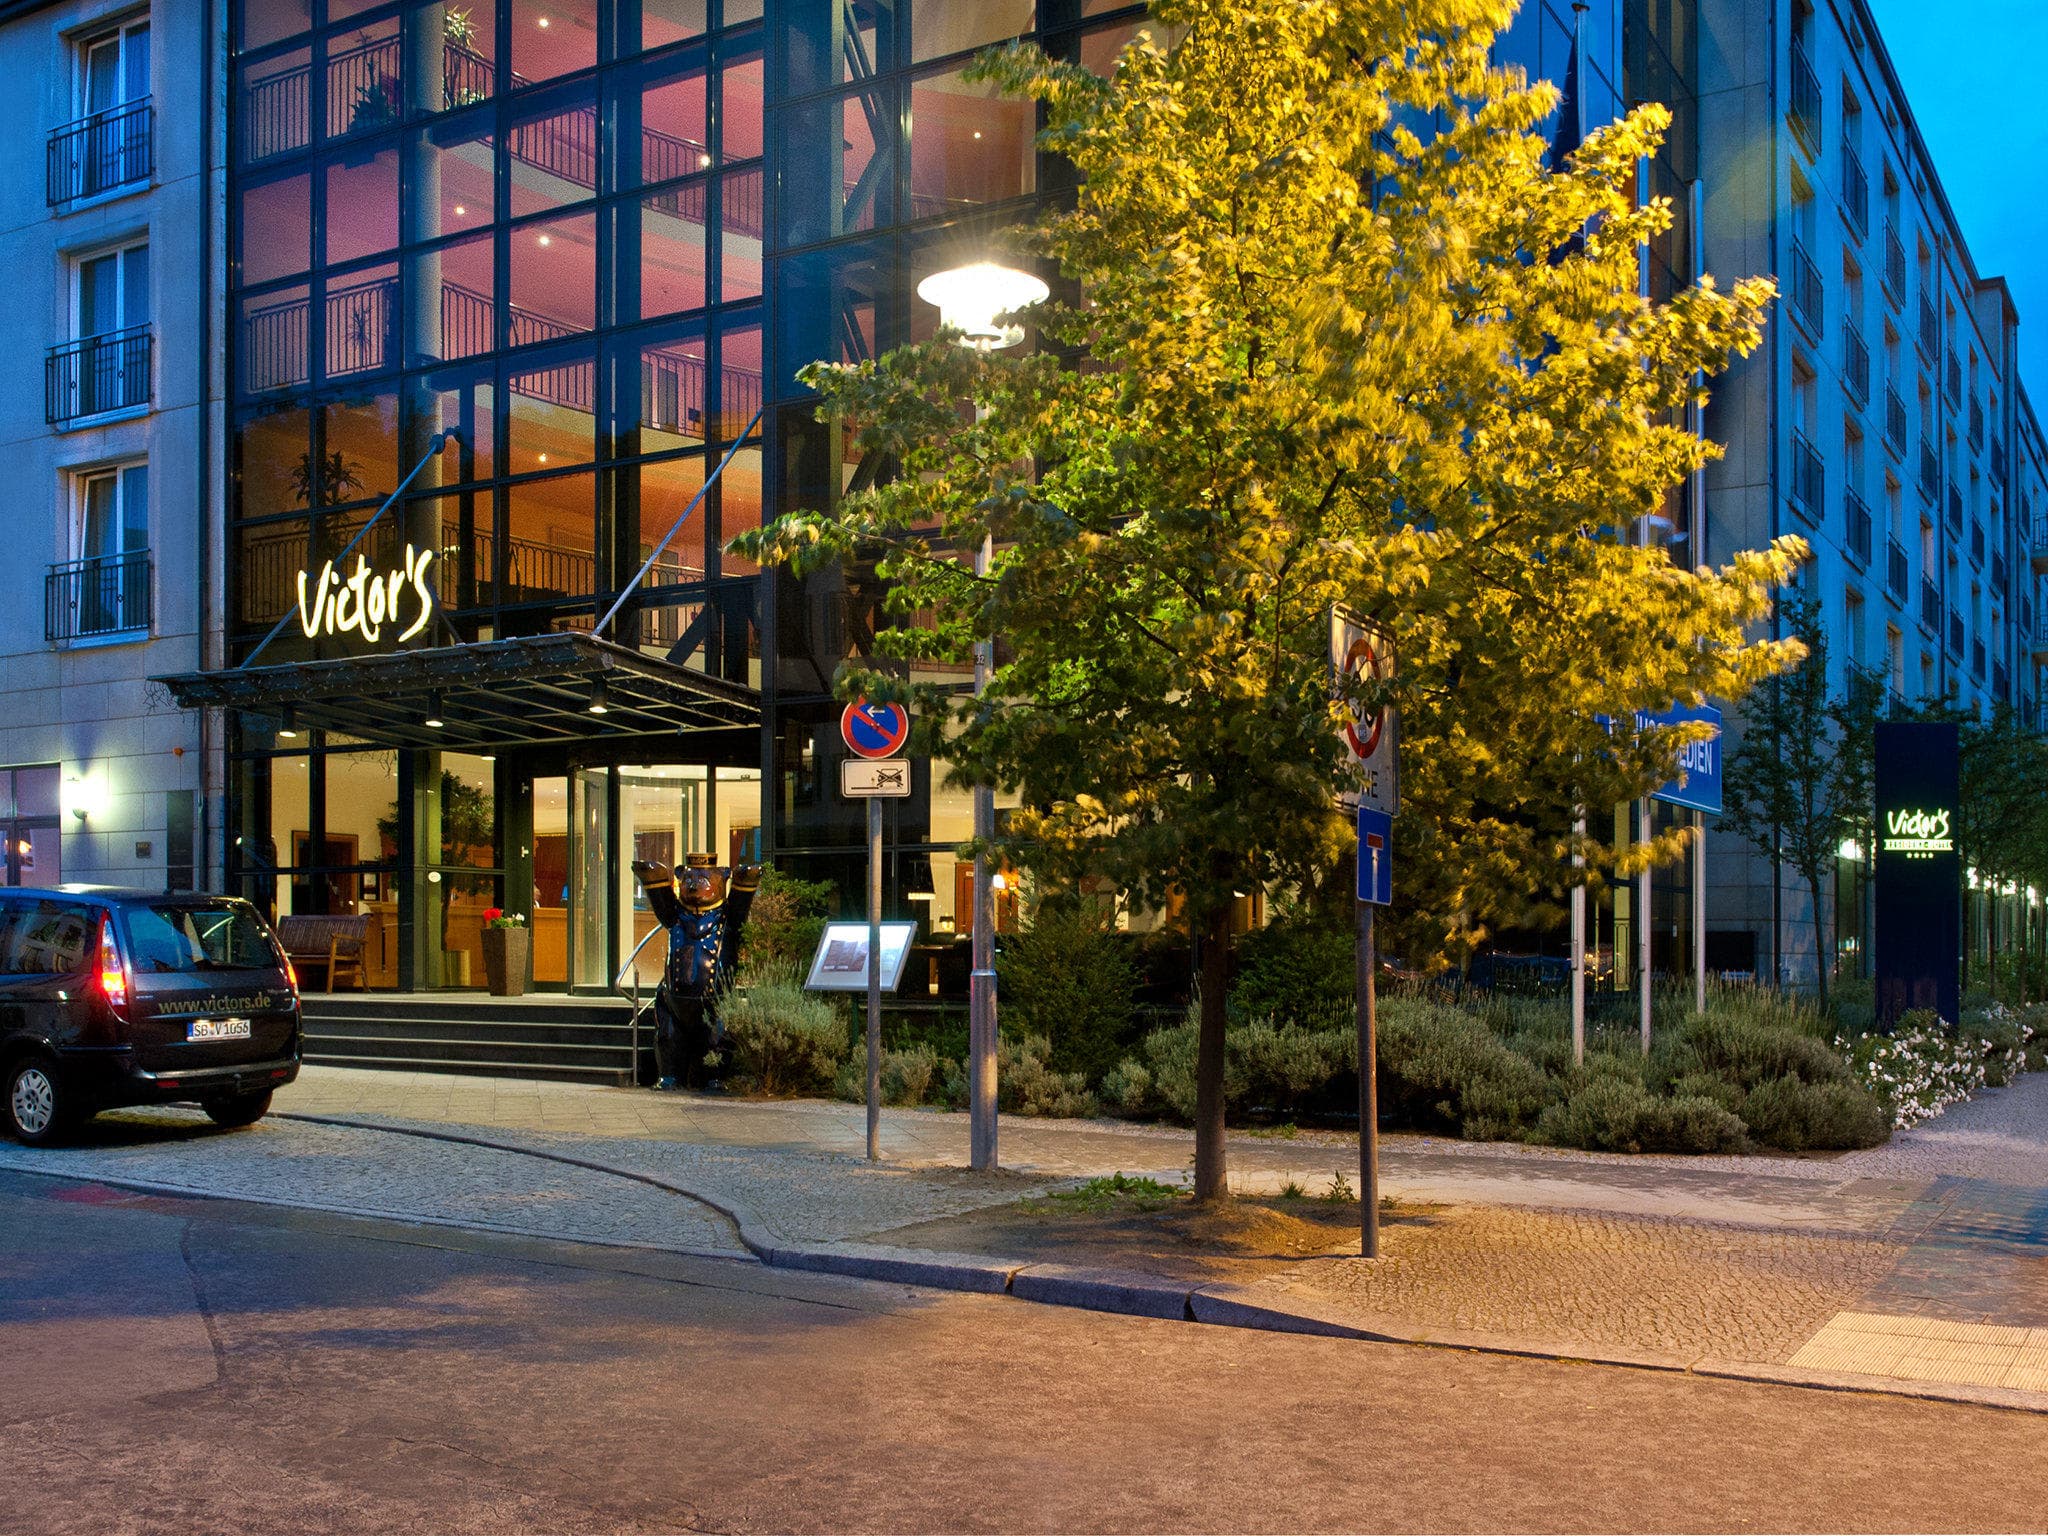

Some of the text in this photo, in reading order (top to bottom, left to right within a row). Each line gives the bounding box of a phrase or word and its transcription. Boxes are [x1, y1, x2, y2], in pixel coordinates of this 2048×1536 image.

[298, 543, 433, 642] Victor's
[1887, 807, 1950, 838] Victor's
[158, 991, 271, 1014] www.victors.de
[224, 1022, 249, 1034] 1056
